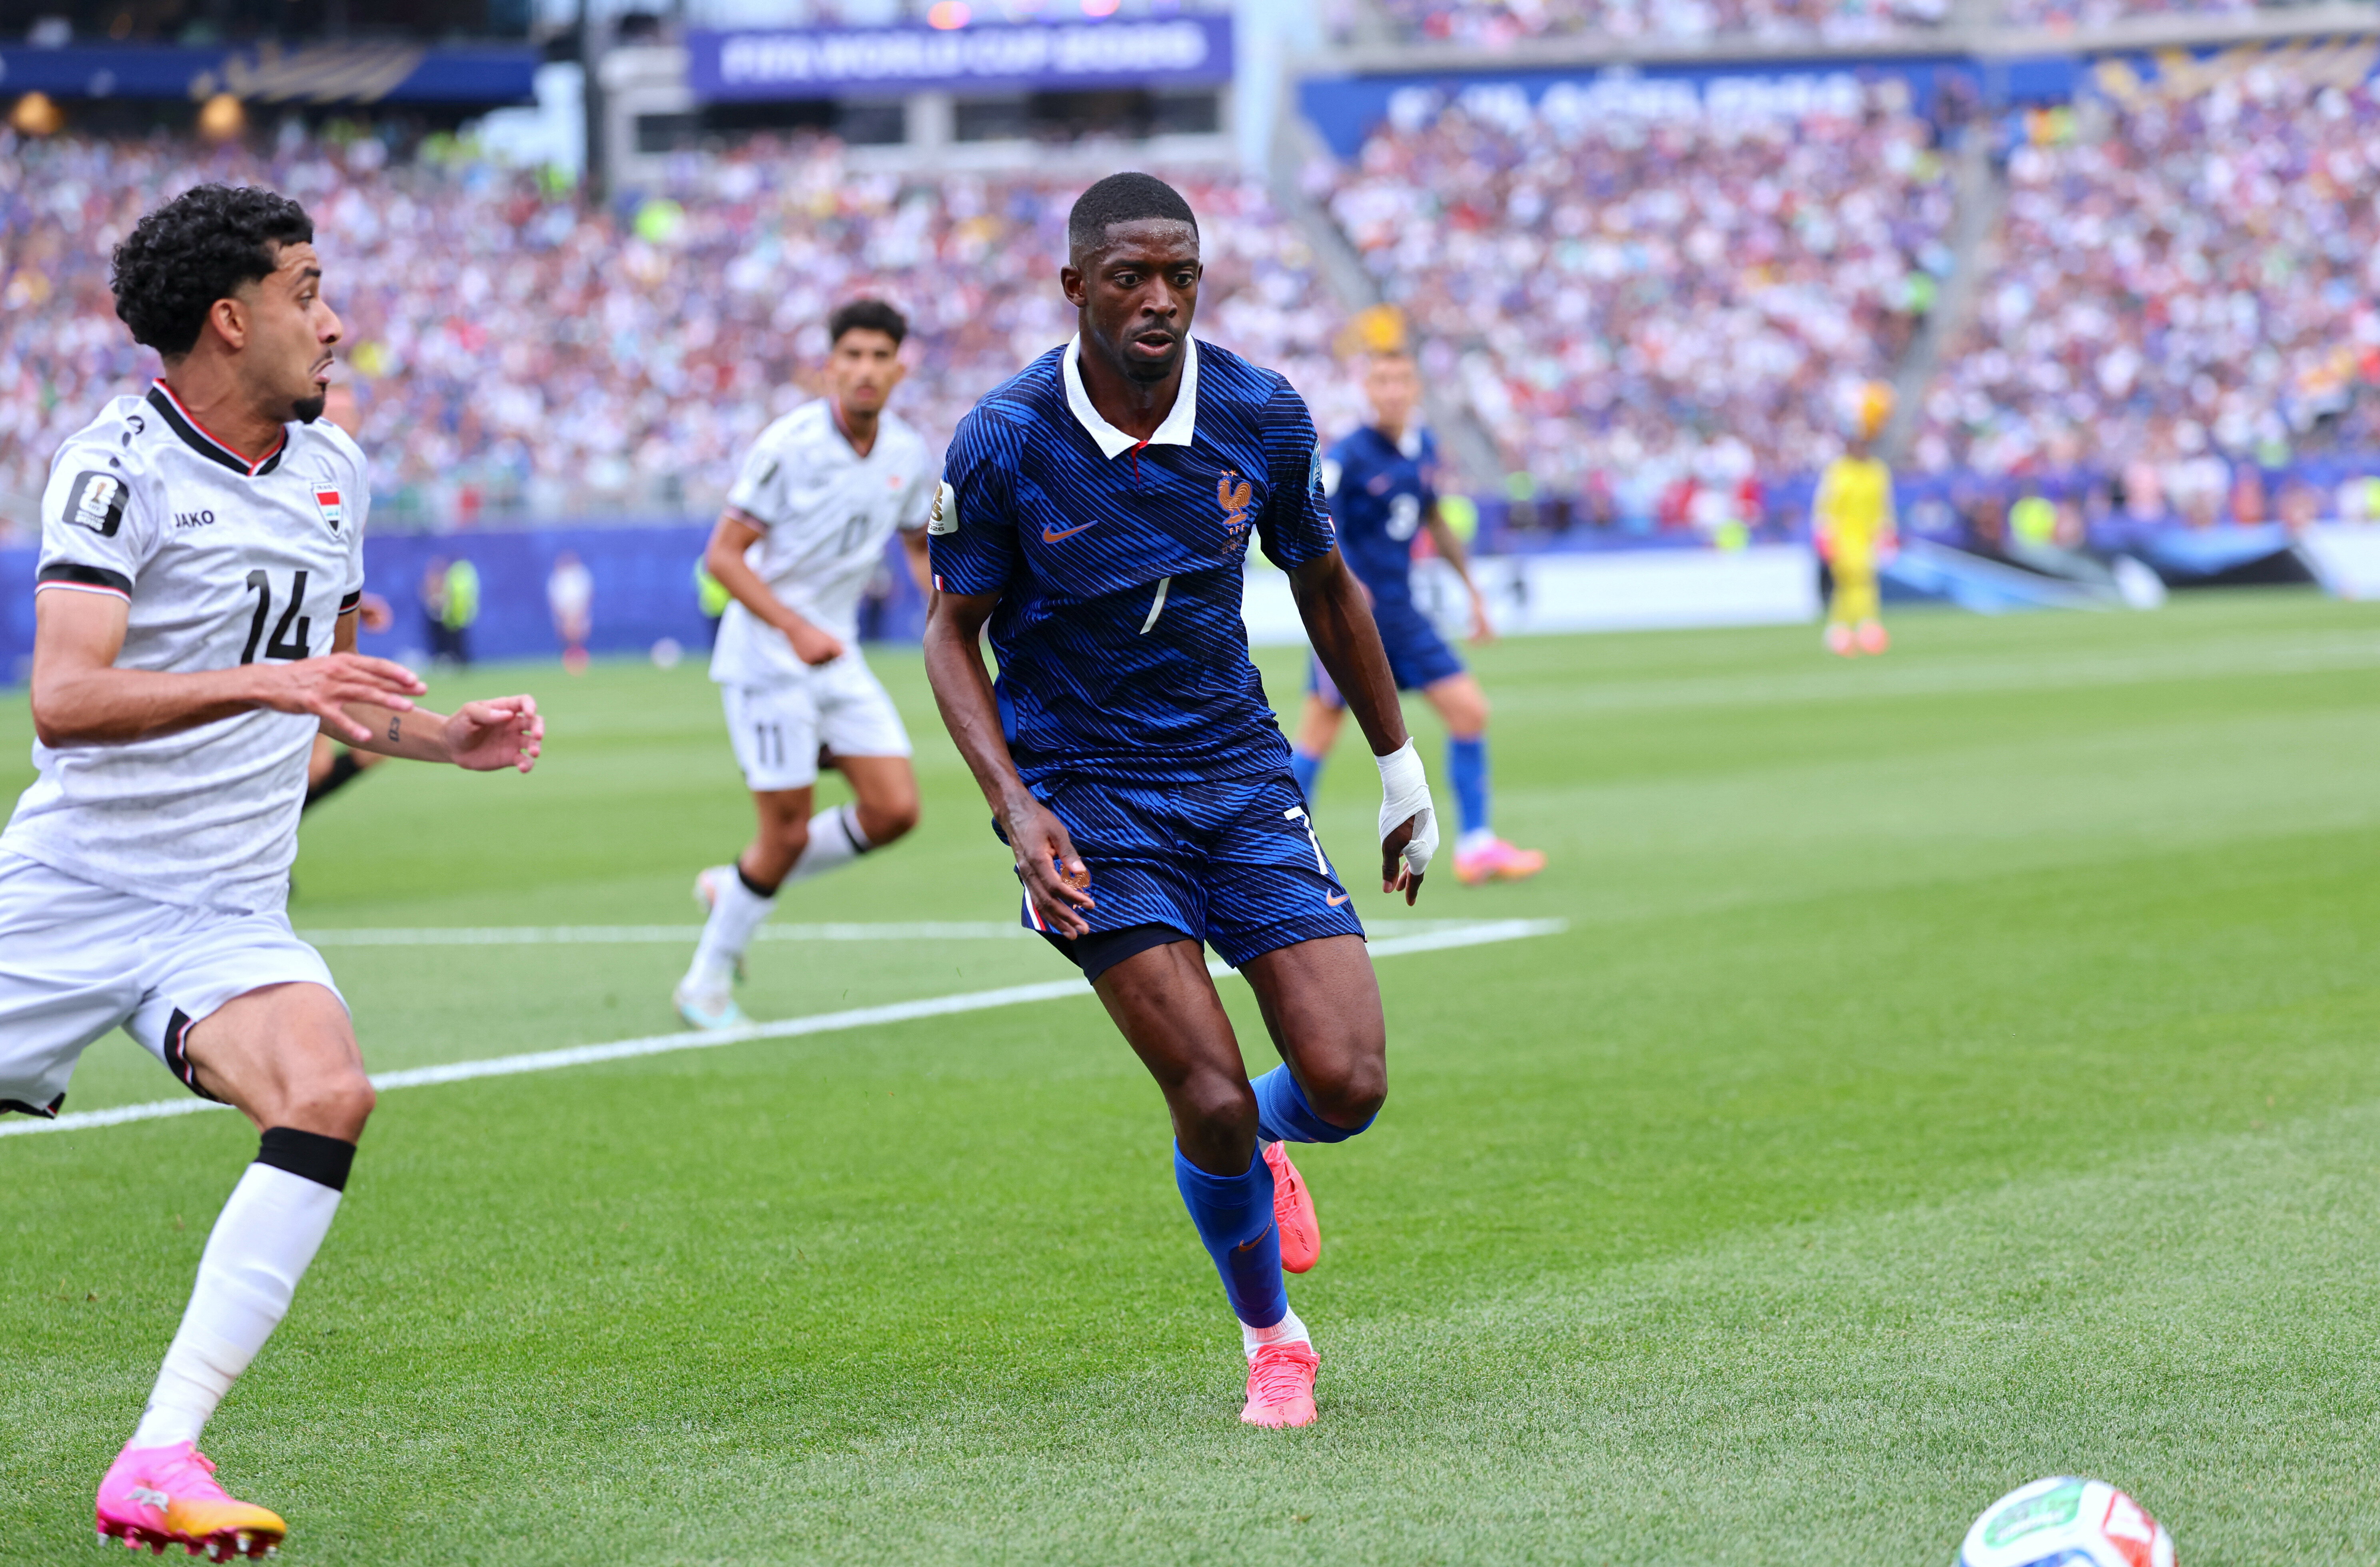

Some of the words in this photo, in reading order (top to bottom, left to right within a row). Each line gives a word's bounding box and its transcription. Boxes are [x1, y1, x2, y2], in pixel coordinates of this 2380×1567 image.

[175, 511, 214, 527] JAKO
[1385, 492, 1420, 541] 3
[241, 570, 310, 665] 14
[755, 723, 785, 767] 11
[1284, 806, 1328, 875] 7
